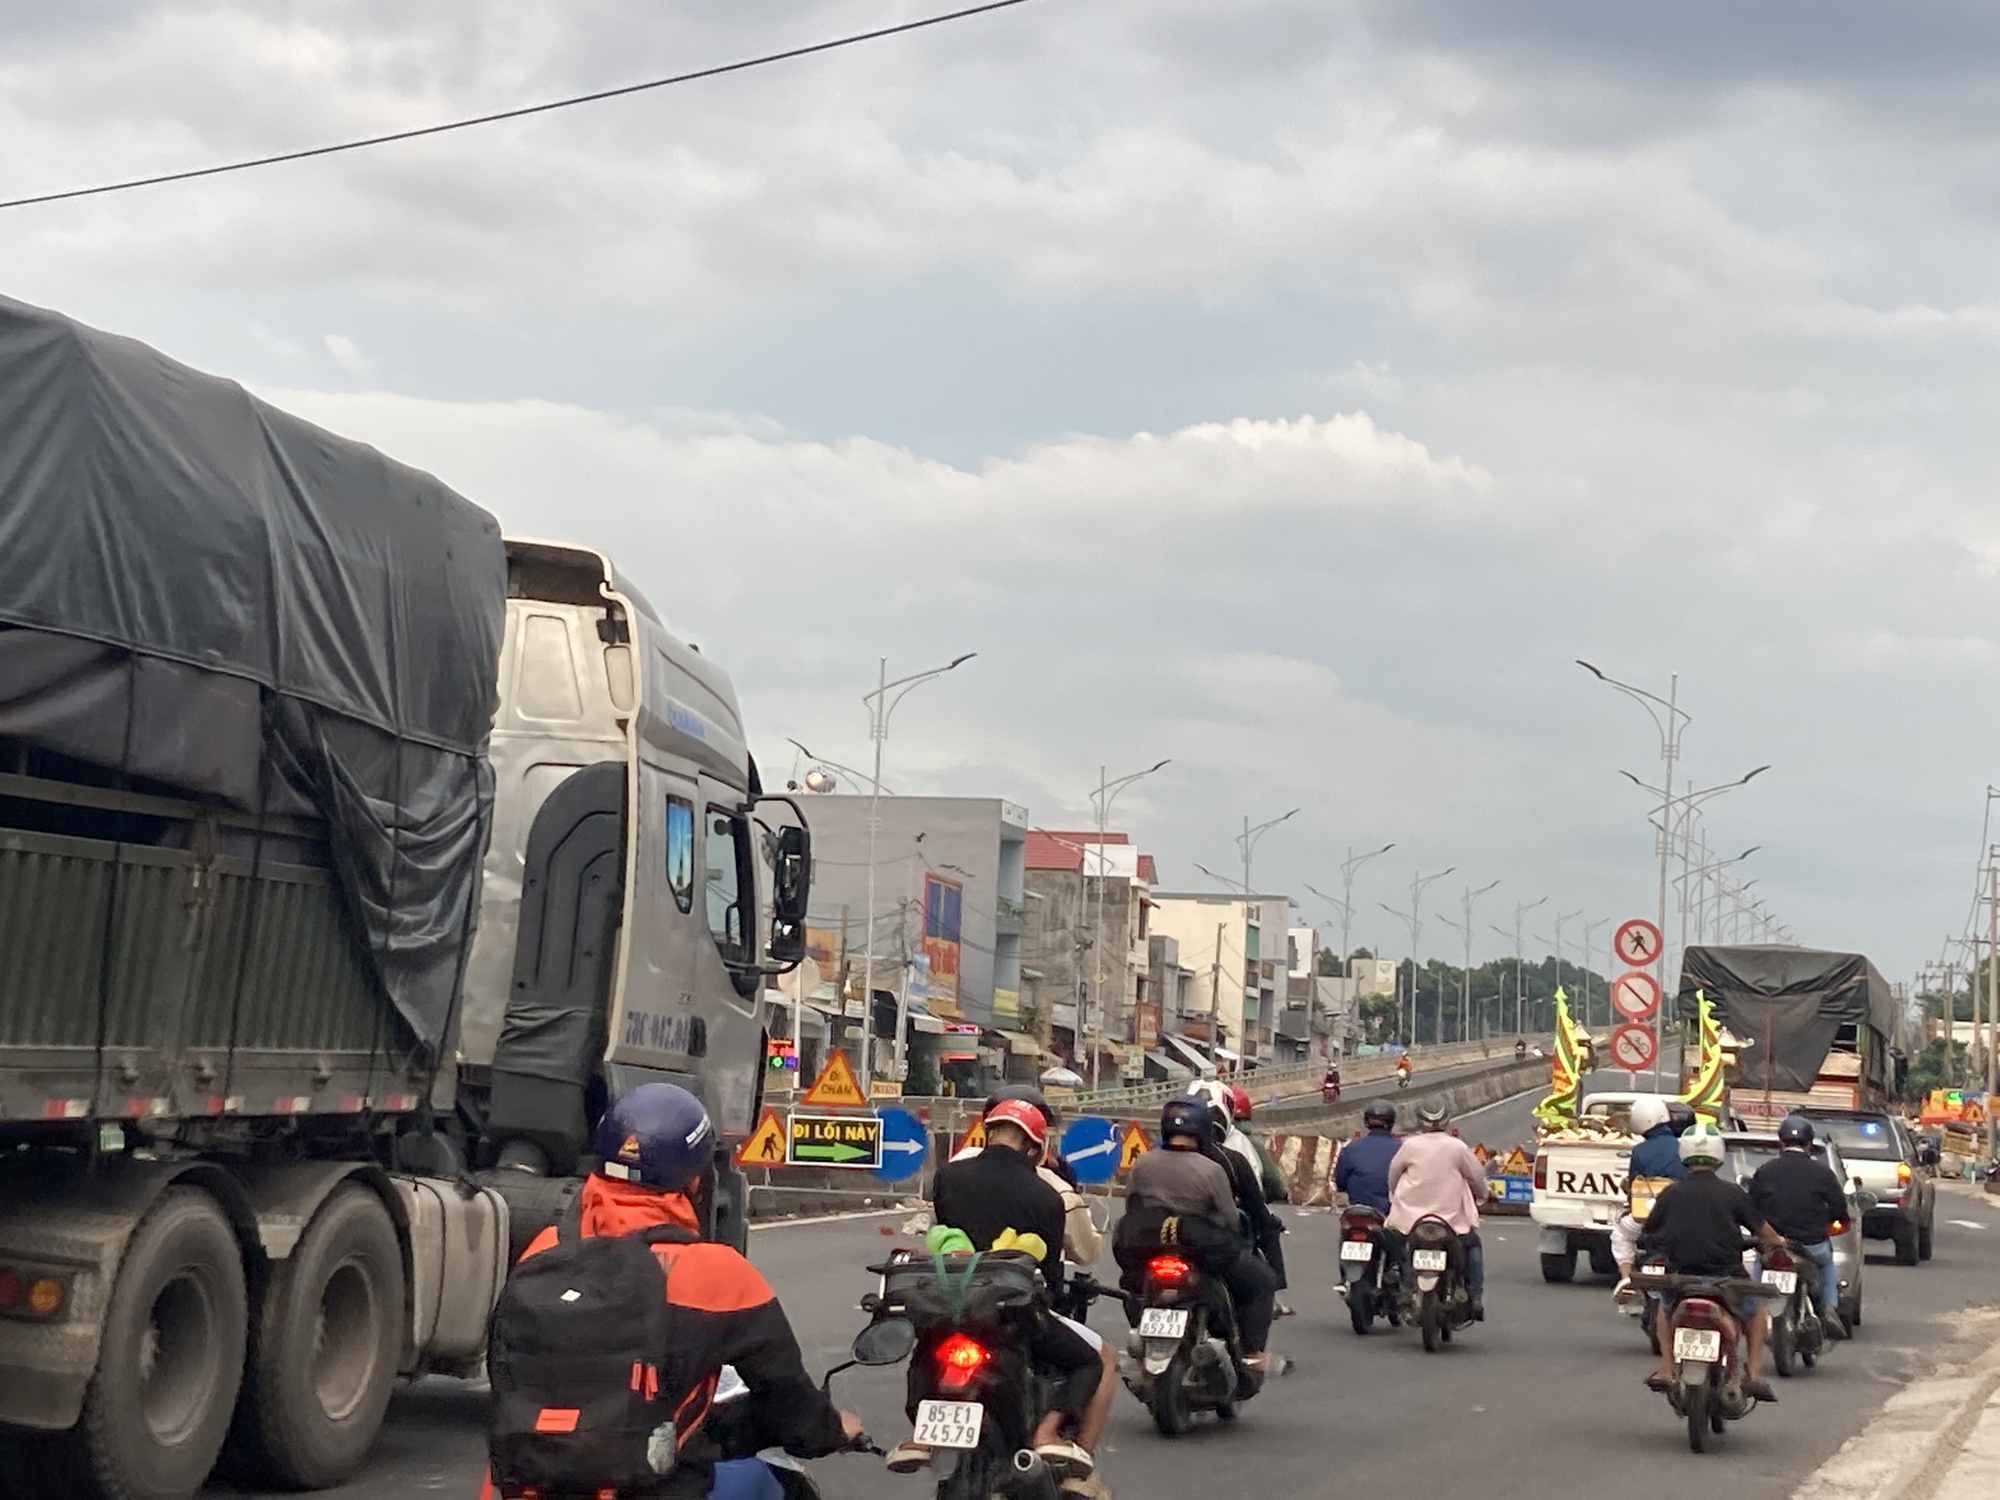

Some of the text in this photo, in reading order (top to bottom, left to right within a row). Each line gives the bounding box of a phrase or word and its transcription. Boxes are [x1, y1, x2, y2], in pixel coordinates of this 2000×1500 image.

[845, 1122, 877, 1141] NÀY
[1555, 1170, 1630, 1196] RAN
[928, 1405, 971, 1424] 85-E1
[918, 1424, 975, 1444] 245.79
